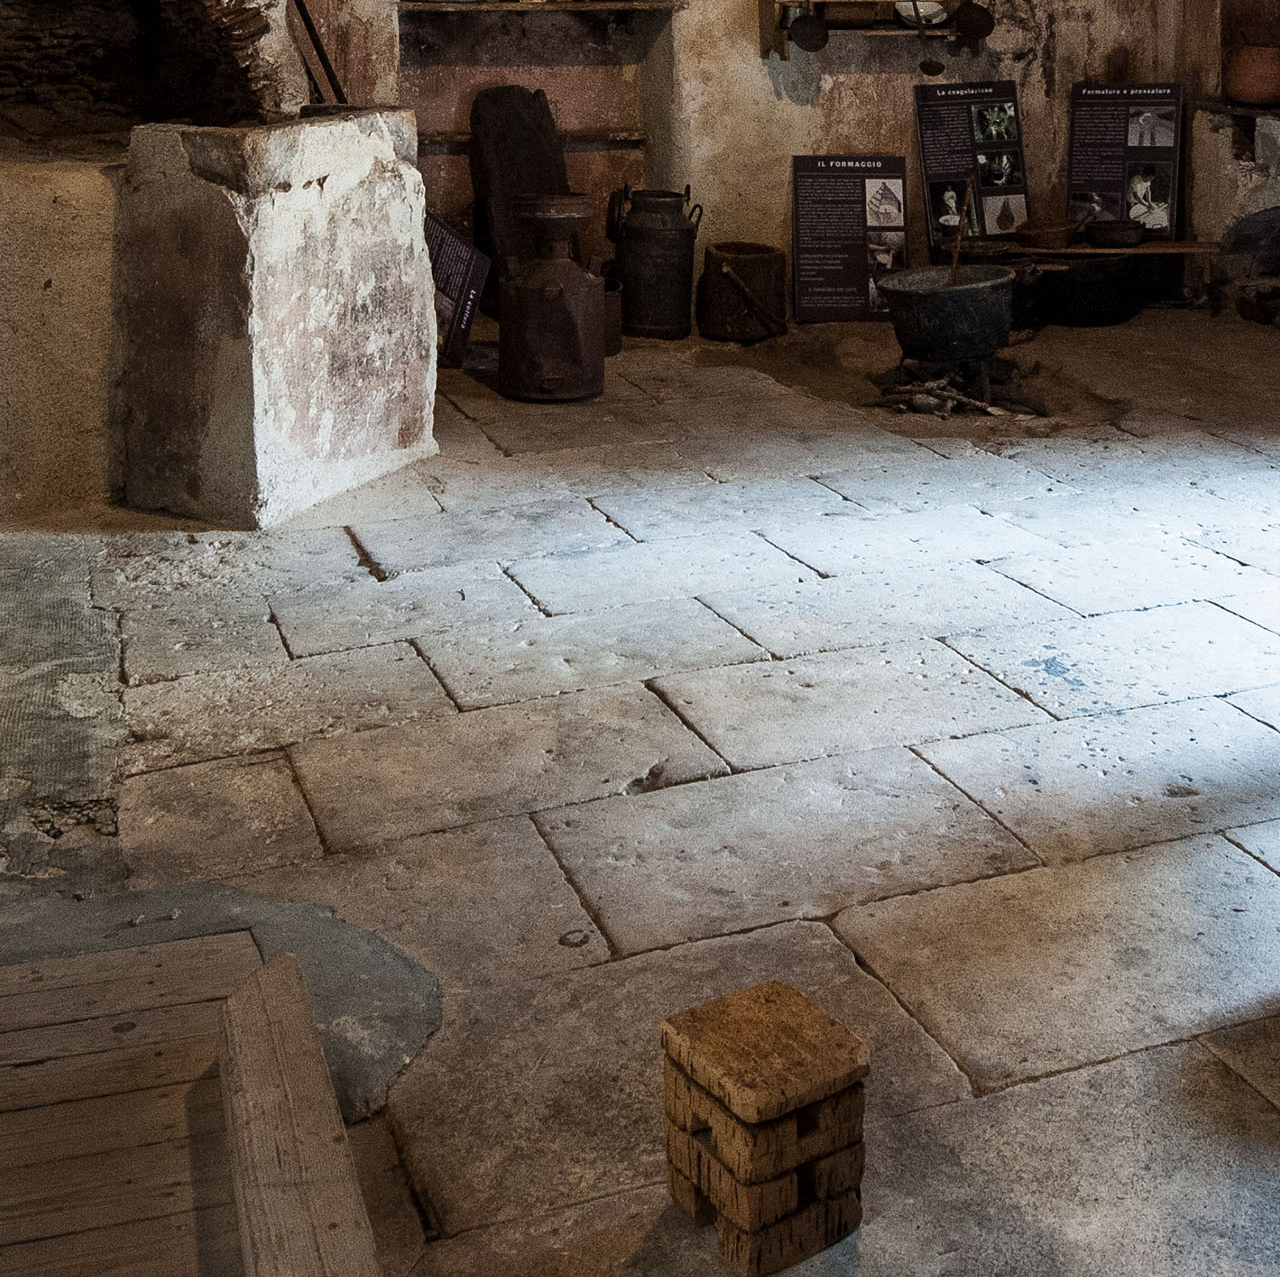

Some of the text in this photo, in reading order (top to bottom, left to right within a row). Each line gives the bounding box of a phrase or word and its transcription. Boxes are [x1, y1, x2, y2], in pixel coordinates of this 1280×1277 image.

[947, 87, 993, 96] coagulazione
[1130, 88, 1171, 96] pressatura
[817, 160, 882, 168] IL FORMAGGIO
[460, 289, 477, 329] La cottura
